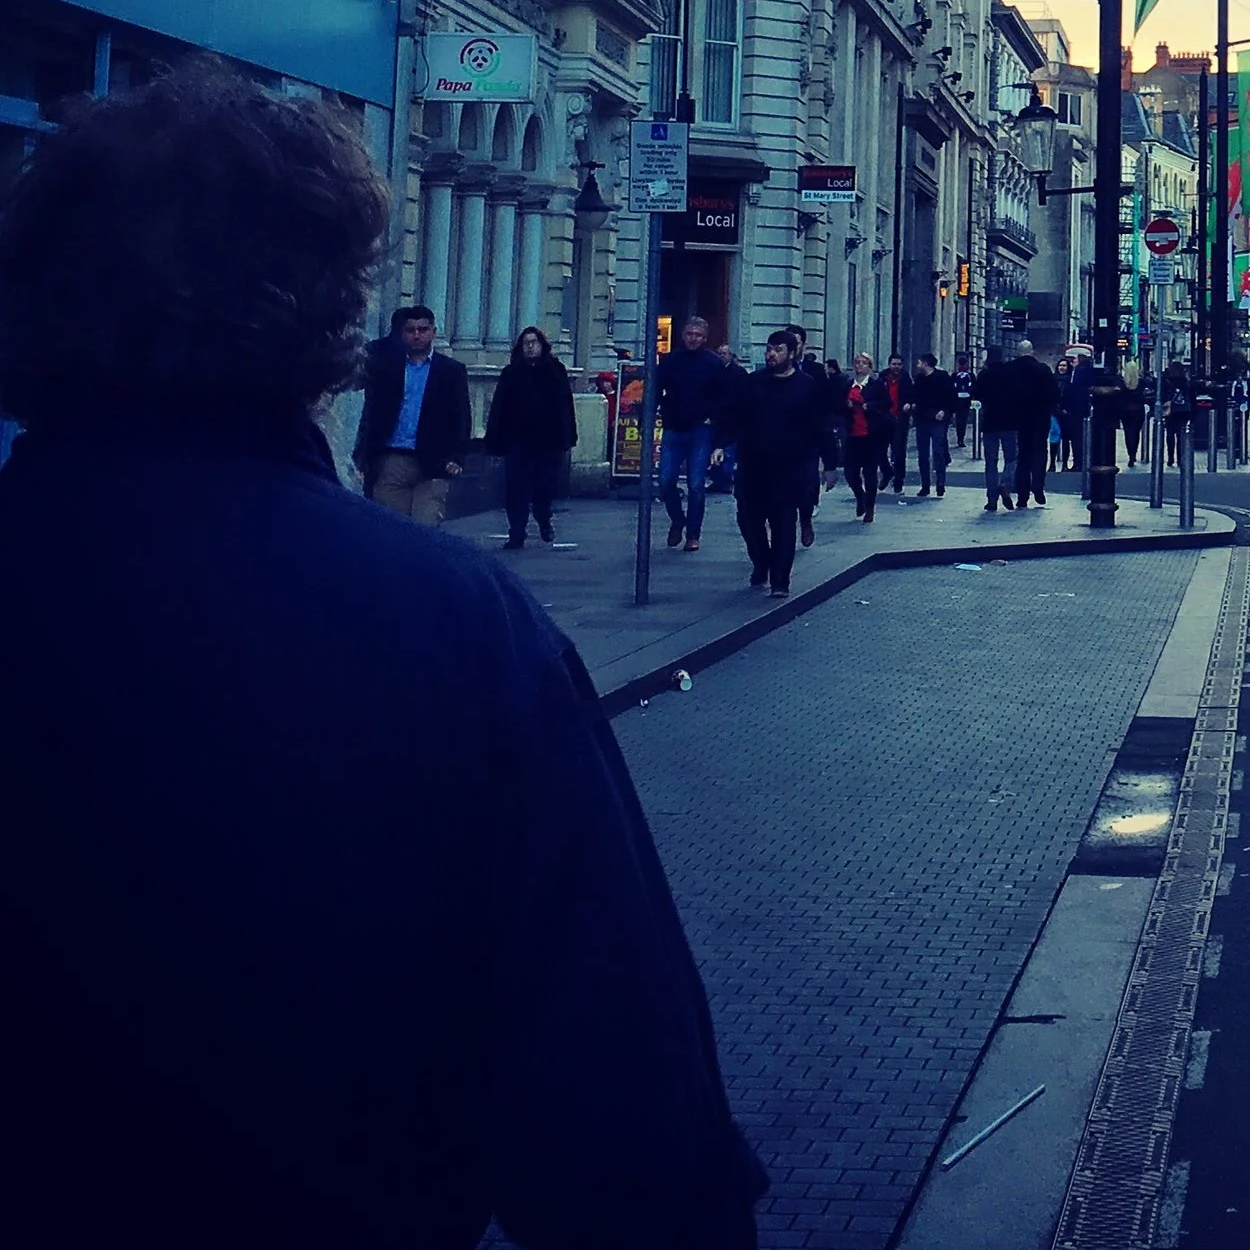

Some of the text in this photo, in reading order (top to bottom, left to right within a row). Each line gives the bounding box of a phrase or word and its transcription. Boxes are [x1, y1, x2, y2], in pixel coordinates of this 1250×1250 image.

[436, 78, 473, 93] Papa
[827, 178, 853, 188] Local
[813, 192, 831, 200] Mary
[832, 192, 854, 200] Street
[697, 211, 735, 228] Local
